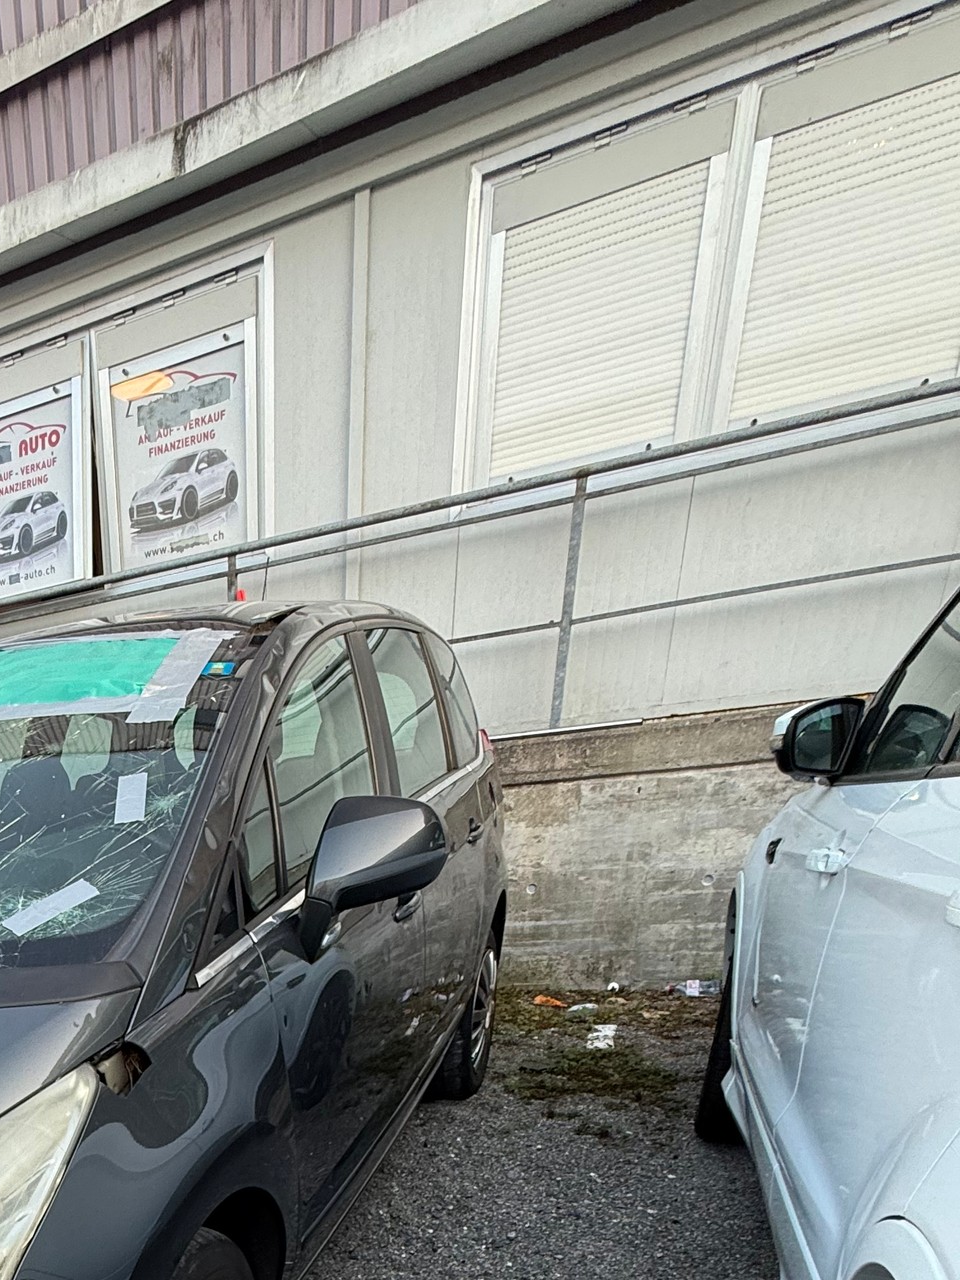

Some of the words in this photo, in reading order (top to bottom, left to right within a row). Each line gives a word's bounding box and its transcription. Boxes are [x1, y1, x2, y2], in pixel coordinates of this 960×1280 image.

[19, 429, 61, 458] AUTO
[138, 427, 174, 445] ANAUF
[149, 429, 216, 458] FINANZIERUNG
[20, 456, 57, 476] VERKAUF
